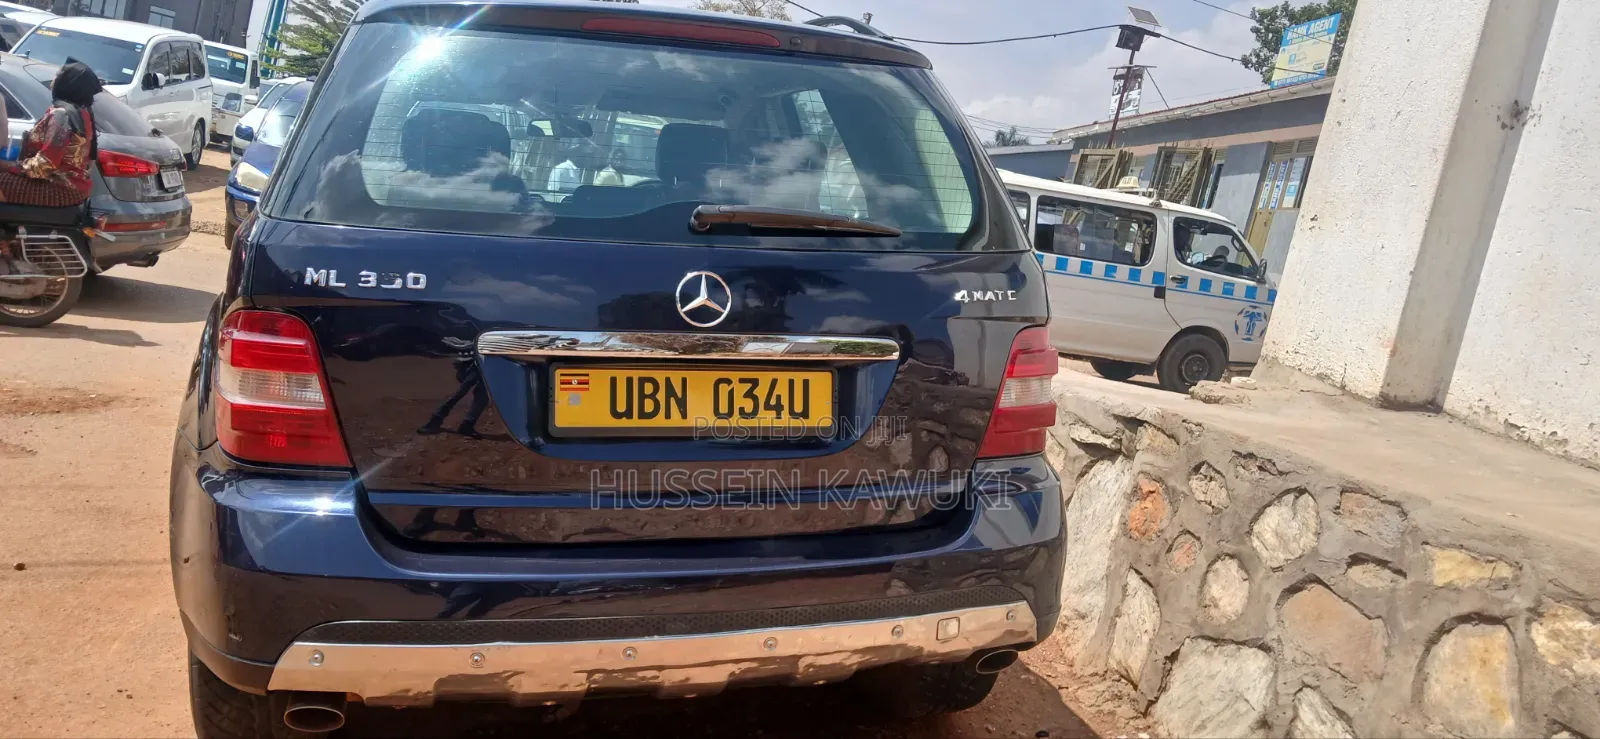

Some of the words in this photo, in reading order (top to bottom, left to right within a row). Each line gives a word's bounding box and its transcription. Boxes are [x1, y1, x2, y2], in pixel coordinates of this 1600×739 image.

[1287, 25, 1308, 40] BANK
[1309, 17, 1336, 35] AGENT
[303, 266, 347, 288] ML
[609, 376, 688, 420] UBN
[713, 377, 811, 420] 034U
